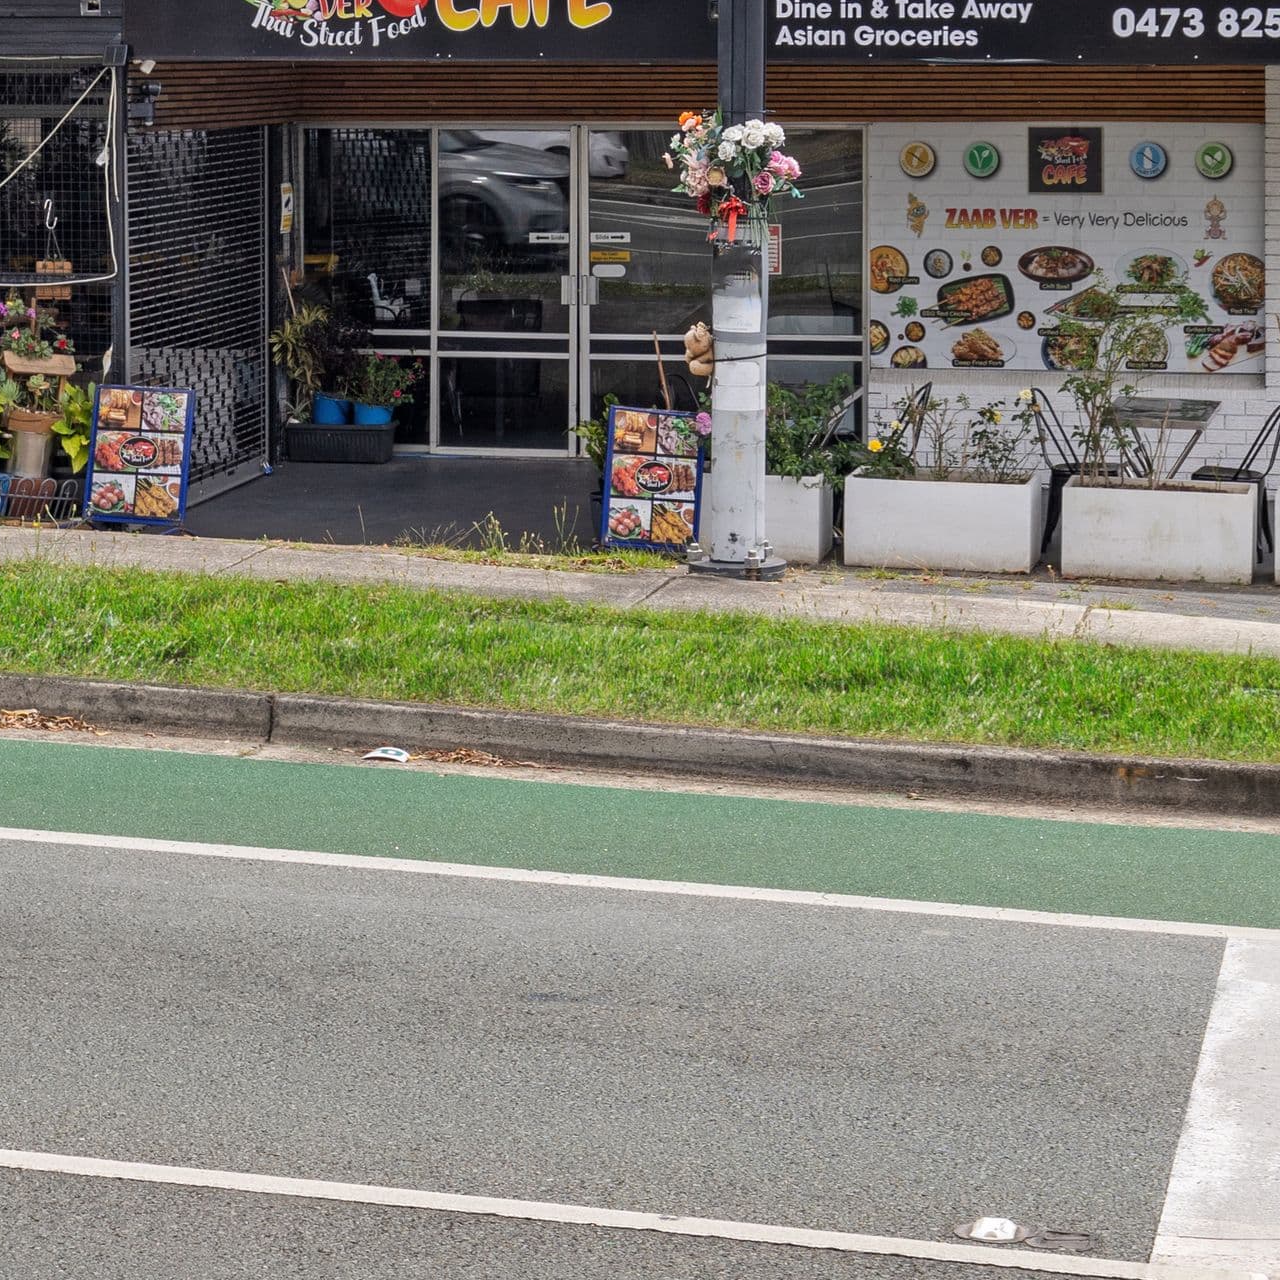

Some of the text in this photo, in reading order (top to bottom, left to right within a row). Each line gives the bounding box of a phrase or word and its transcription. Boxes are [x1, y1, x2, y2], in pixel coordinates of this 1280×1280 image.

[251, 0, 427, 47] Thai Street Food
[775, 25, 978, 46] Asian Groceries
[1112, 7, 1205, 38] 0473
[944, 208, 998, 229] ZAAB
[999, 208, 1039, 229] VER
[1054, 211, 1084, 229] Very
[1088, 211, 1119, 229] Very
[1122, 211, 1189, 227] Delicious
